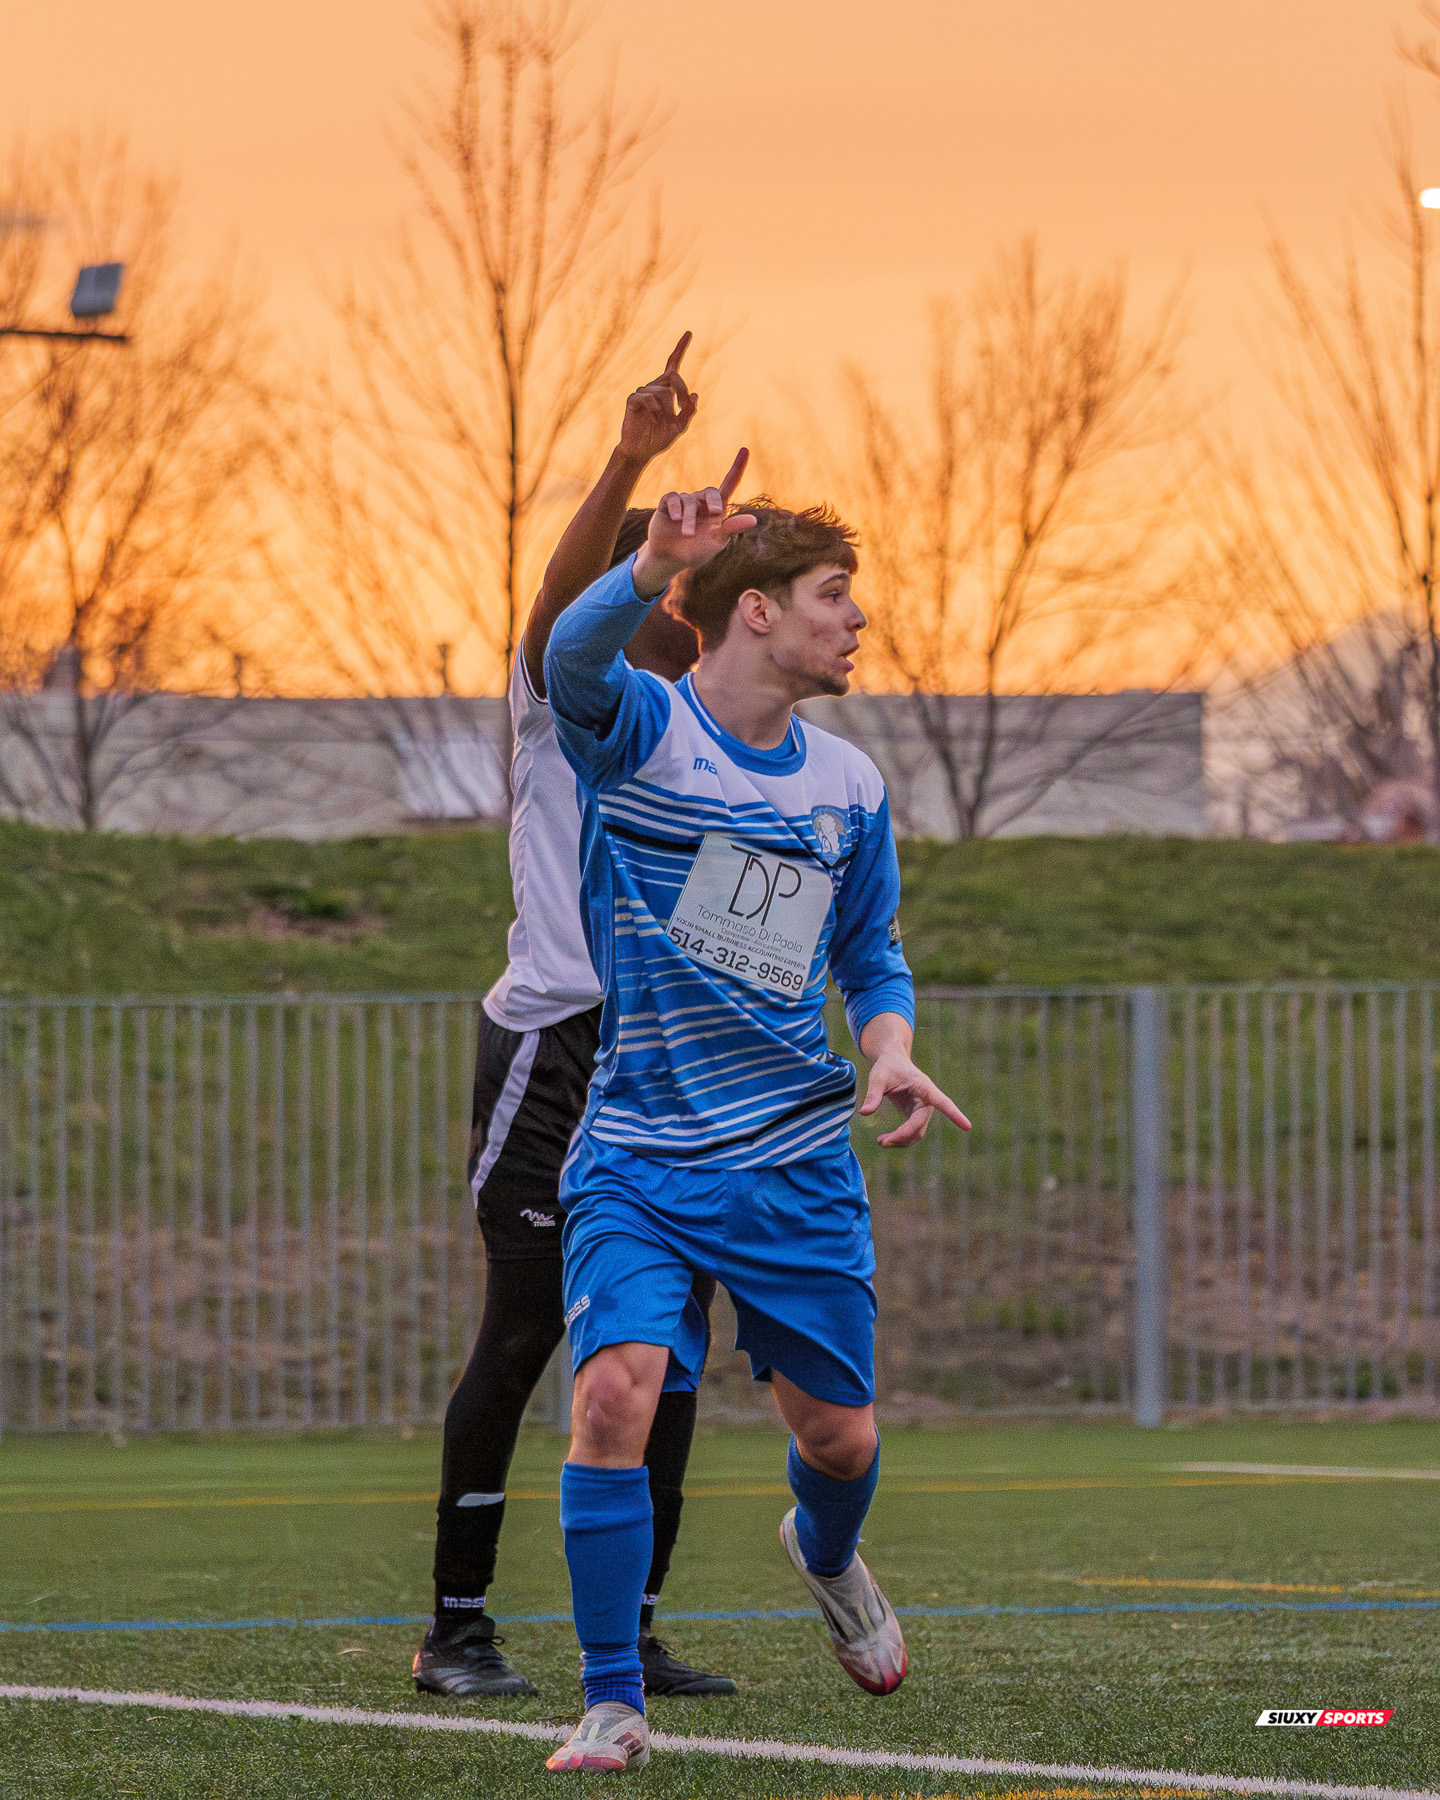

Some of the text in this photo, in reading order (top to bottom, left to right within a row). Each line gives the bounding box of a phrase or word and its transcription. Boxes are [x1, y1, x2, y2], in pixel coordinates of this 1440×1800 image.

[695, 923, 716, 938] SMALL
[717, 933, 747, 949] BUSINESS
[748, 946, 784, 963] ACCOUNTING
[698, 904, 757, 937] Tommaso
[759, 928, 771, 941] Di
[772, 932, 803, 953] Paola
[669, 926, 804, 991] 514-312-9569
